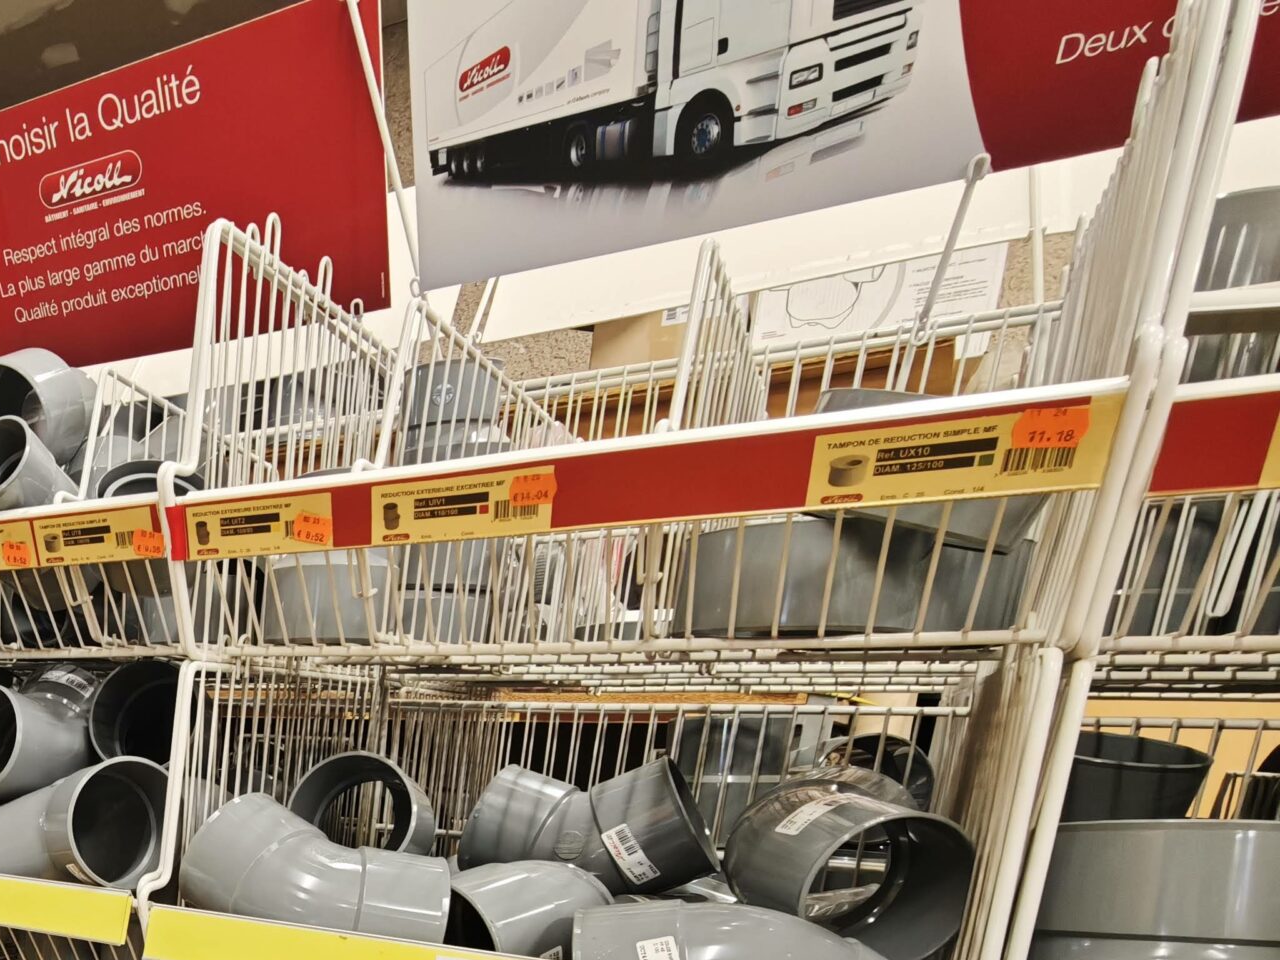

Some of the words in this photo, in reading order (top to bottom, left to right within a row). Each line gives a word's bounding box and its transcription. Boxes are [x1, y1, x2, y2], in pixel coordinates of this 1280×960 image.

[1055, 21, 1153, 65] Deux
[463, 54, 505, 89] Nicoll
[66, 108, 92, 142] la
[97, 65, 201, 131] Qualité
[51, 160, 132, 204] Nicoll
[3, 238, 58, 267] Respect
[60, 222, 110, 253] intégral
[113, 215, 141, 238] des
[144, 200, 207, 229] normes.
[18, 272, 46, 300] plus
[47, 264, 81, 290] large
[83, 250, 136, 283] gamme
[139, 244, 160, 264] du
[162, 230, 205, 258] marc
[14, 300, 59, 324] Qualité
[61, 288, 108, 315] produit
[111, 265, 201, 303] exceptionnel
[827, 439, 866, 450] TAMPON
[868, 437, 882, 447] DE
[883, 432, 940, 445] REDUCTION
[943, 427, 980, 438] SIMPLE
[899, 446, 931, 458] UX10
[906, 460, 944, 472] 125/100
[381, 490, 415, 499] REDUCTION
[416, 486, 454, 495] EXTERIEURE
[456, 482, 494, 491] EXCENTREE
